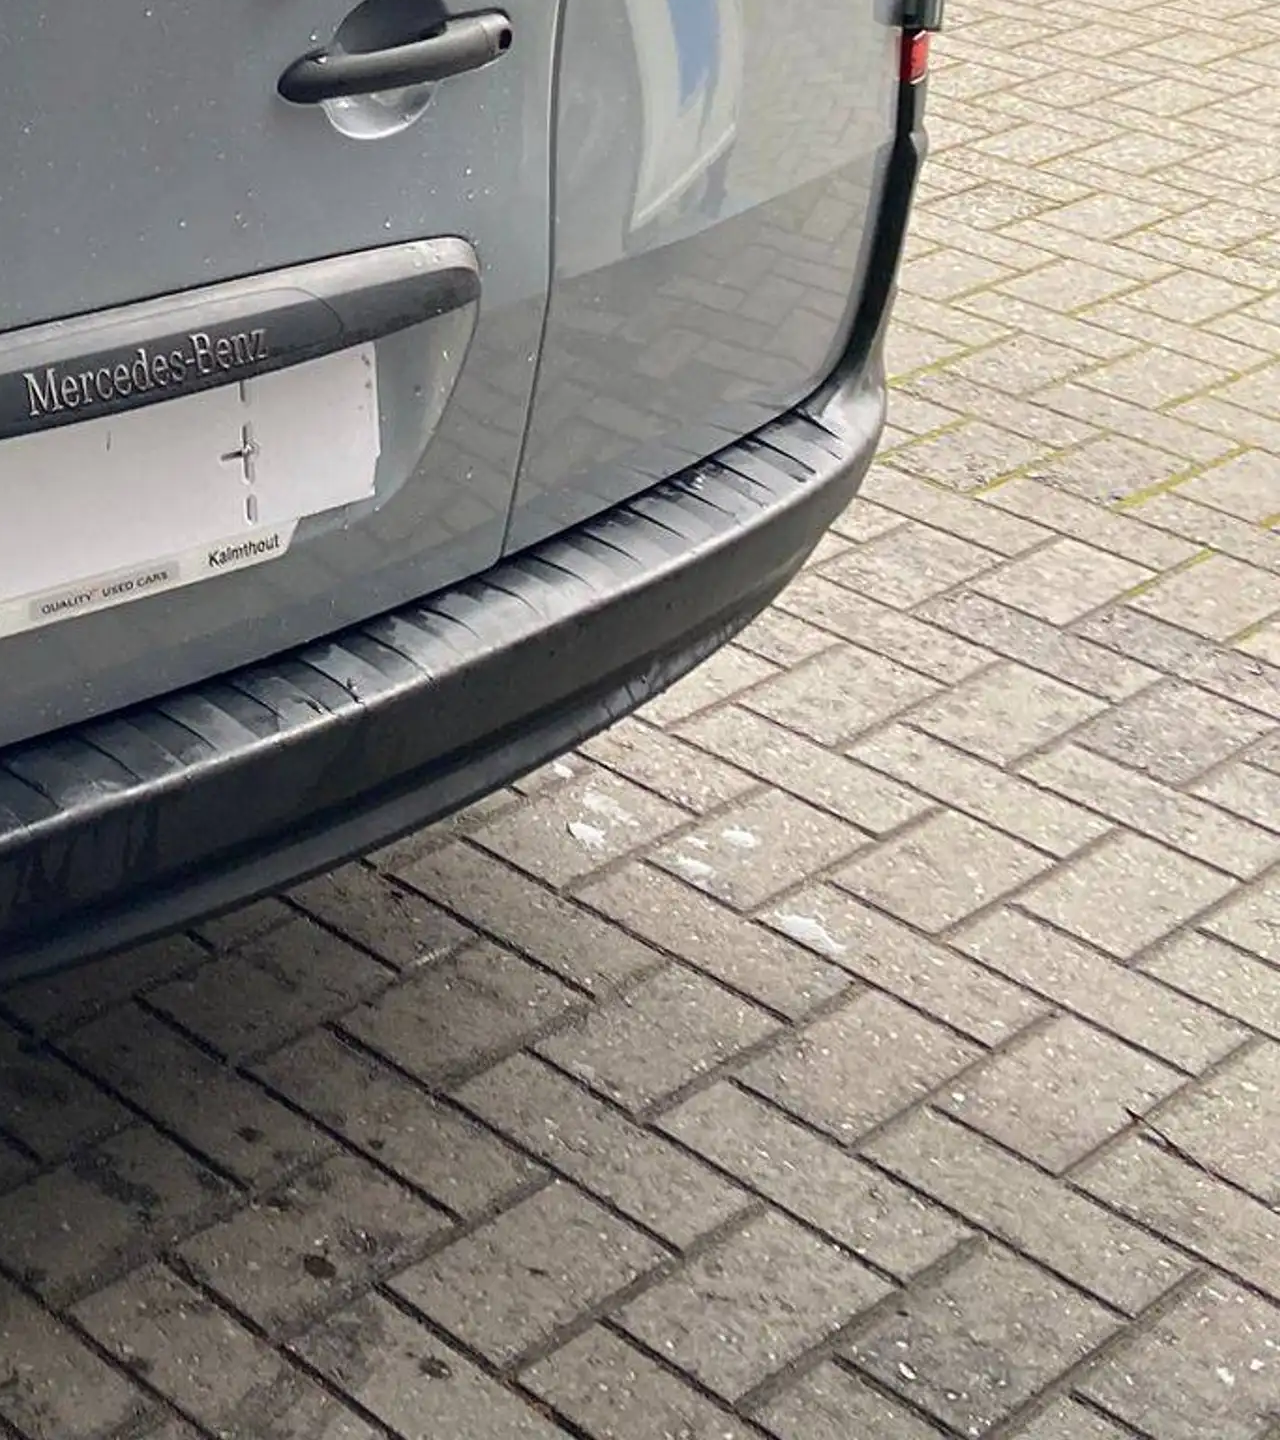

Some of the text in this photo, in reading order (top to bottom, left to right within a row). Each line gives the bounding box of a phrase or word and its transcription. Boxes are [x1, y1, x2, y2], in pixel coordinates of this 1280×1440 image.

[23, 328, 269, 417] Mercedes-Benz
[41, 591, 92, 615] QUALITY
[102, 580, 134, 598] USED
[136, 571, 168, 588] CARS
[208, 533, 280, 567] Kalmthout
